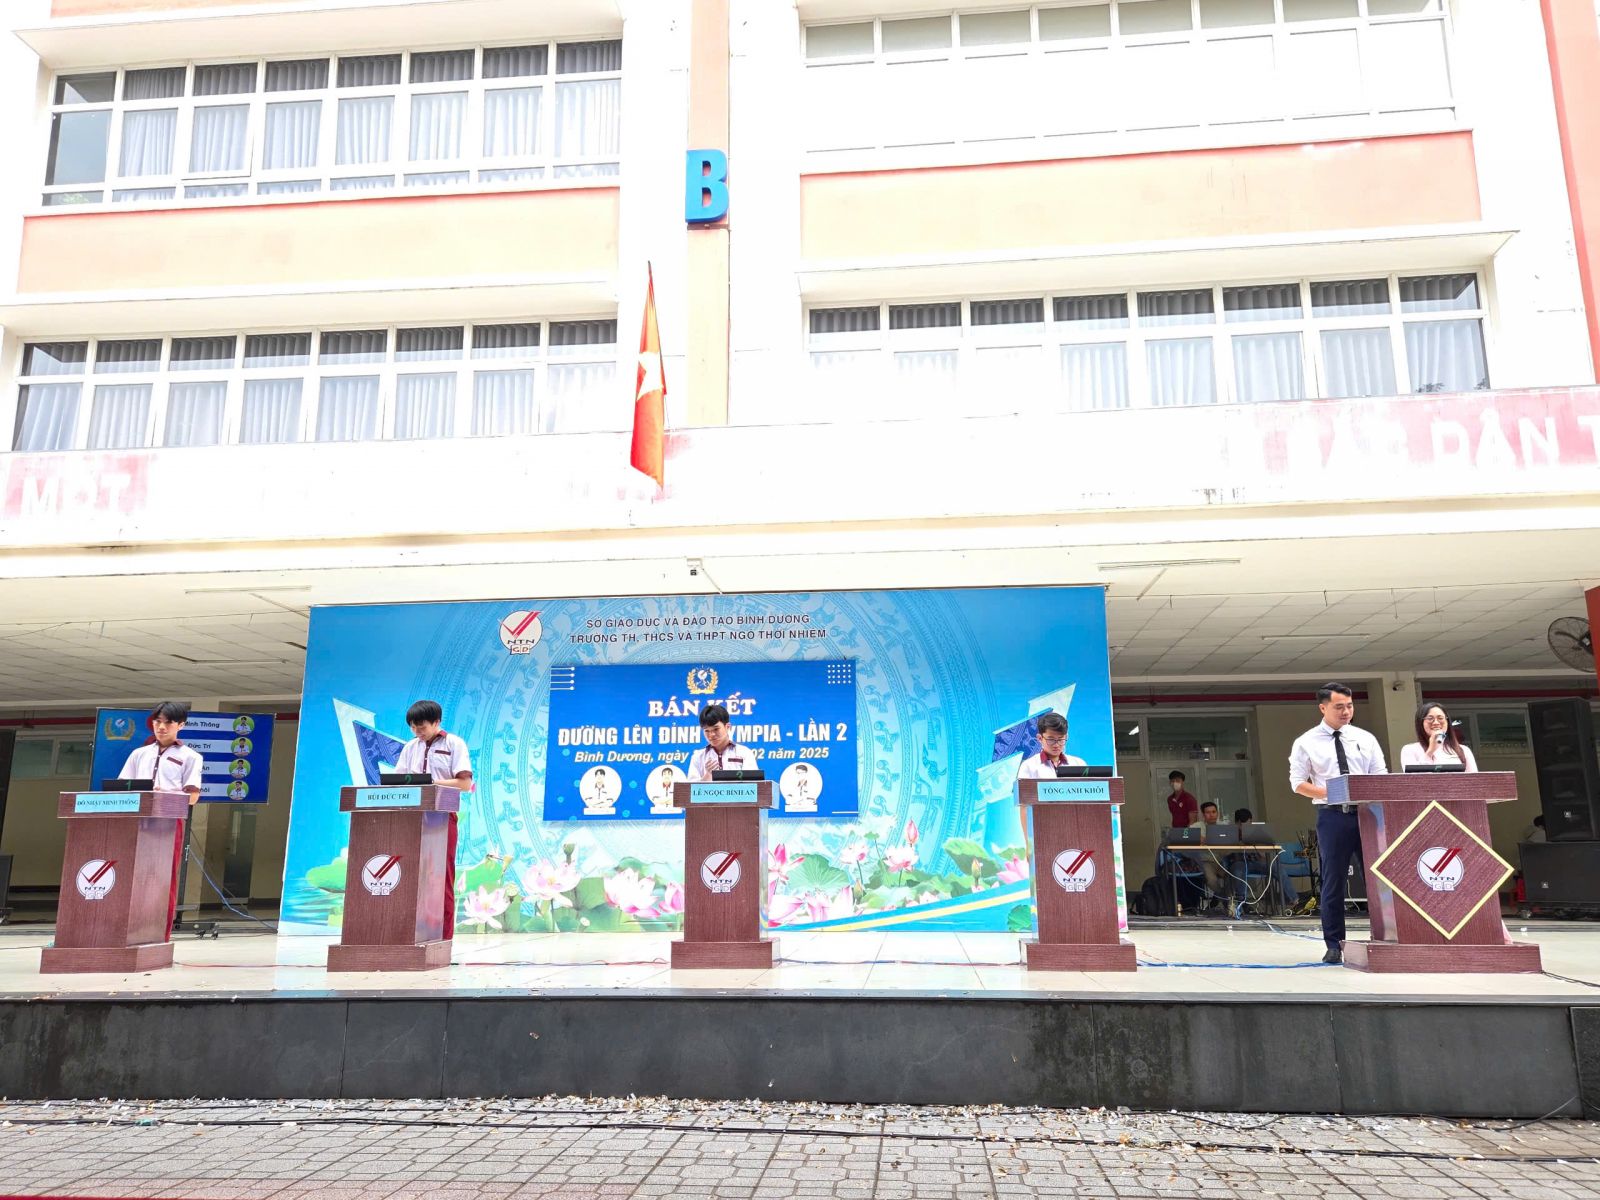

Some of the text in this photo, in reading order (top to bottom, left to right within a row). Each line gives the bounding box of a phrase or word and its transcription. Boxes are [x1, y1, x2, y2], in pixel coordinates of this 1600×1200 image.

[685, 149, 729, 223] B
[682, 615, 707, 626] ĐÀO
[644, 633, 673, 641] THCS
[697, 631, 726, 640] THPT
[648, 691, 757, 717] BÁN ẾT
[558, 724, 618, 746] ĐƯỜNG
[623, 724, 653, 745] LÊN
[658, 722, 701, 744] ĐỈNH
[799, 718, 831, 742] LẦN
[836, 722, 848, 741] 2
[768, 748, 795, 759] năm
[800, 747, 829, 759] 2025
[744, 788, 756, 796] AN
